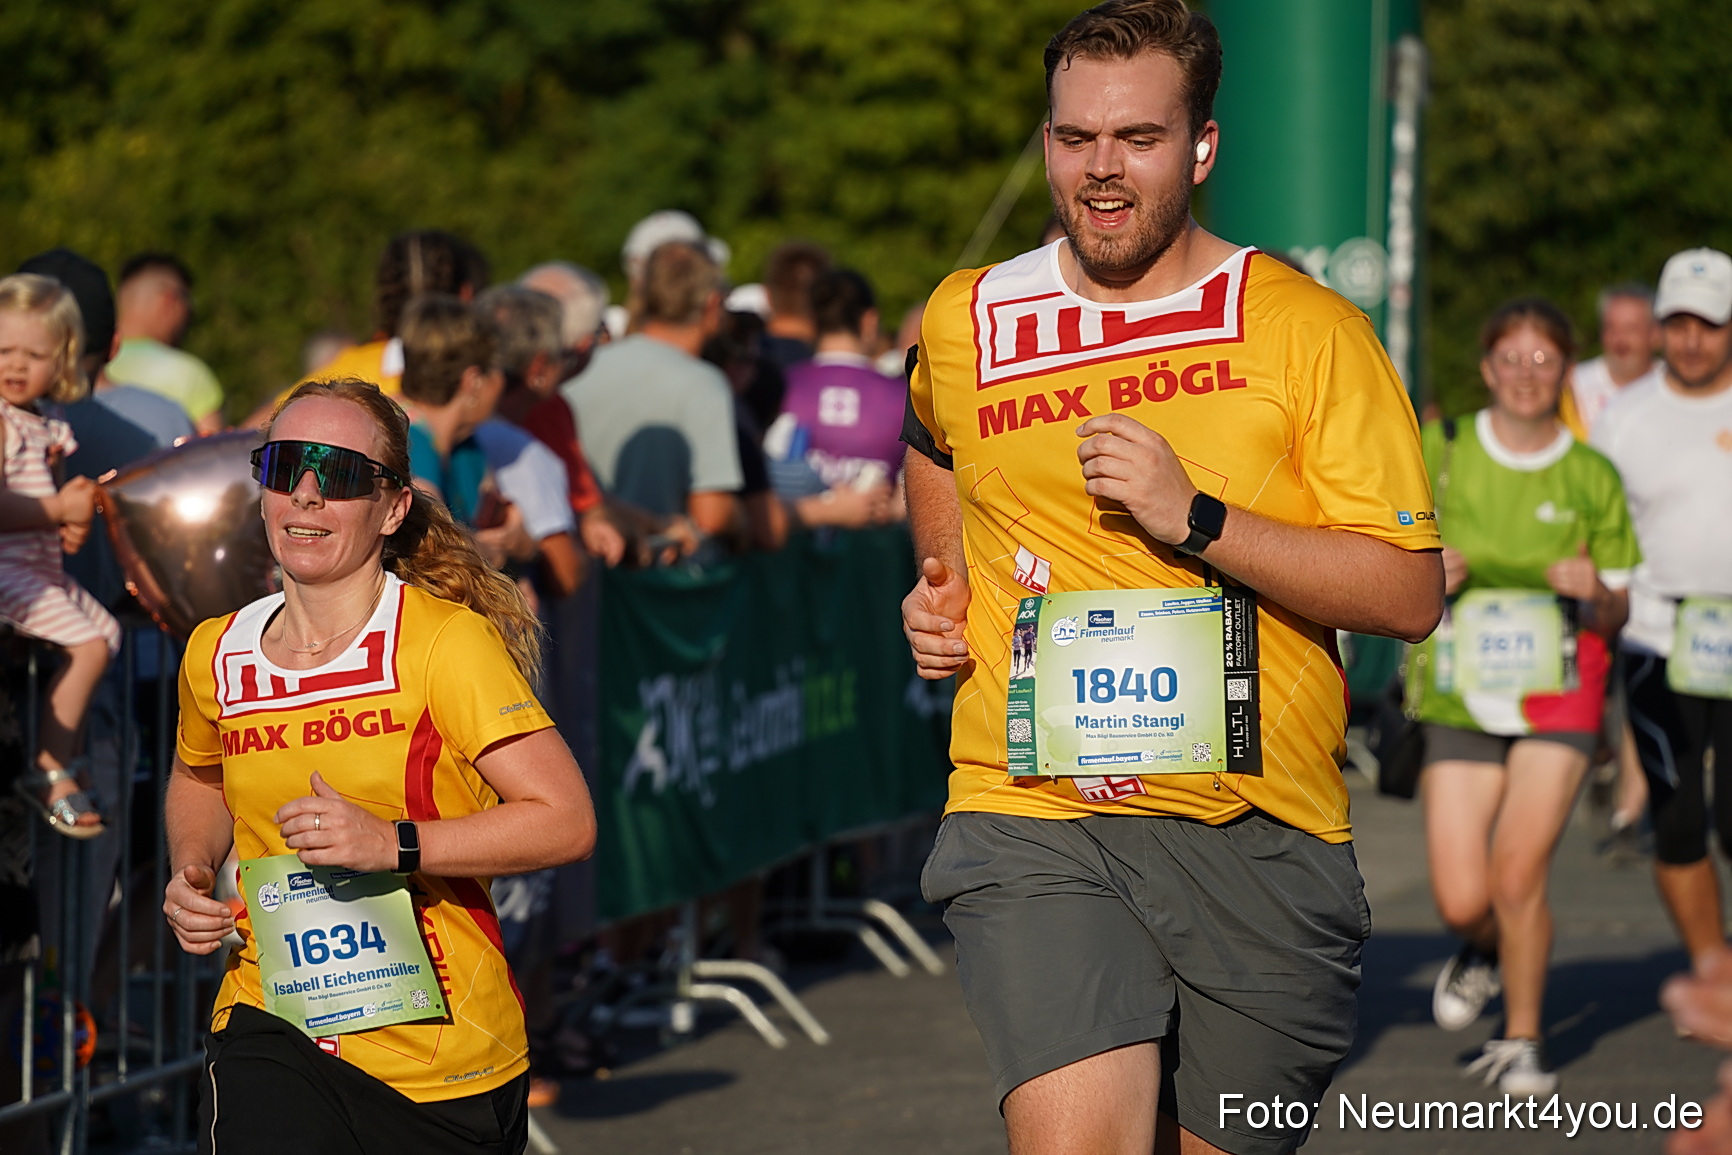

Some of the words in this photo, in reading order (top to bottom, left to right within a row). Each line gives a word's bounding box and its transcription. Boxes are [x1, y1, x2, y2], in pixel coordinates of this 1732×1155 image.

[977, 384, 1092, 440] MAX
[1108, 359, 1247, 411] BÖGL
[1018, 610, 1036, 619] AOK
[1224, 598, 1233, 641] RABATT
[1234, 598, 1242, 630] OUTLET
[1080, 625, 1135, 638] Firmenlauf
[1101, 635, 1134, 643] neumarkt
[1225, 643, 1233, 651] %
[1226, 652, 1234, 667] 20
[1072, 667, 1177, 703] 1840
[1075, 714, 1127, 729] Martin
[1132, 713, 1184, 731] Stangl
[222, 723, 289, 758] MAX
[302, 707, 406, 747] BÖGL
[1232, 705, 1244, 758] HILTL
[1081, 755, 1138, 764] firmenlauf.bayern
[283, 885, 334, 902] Firmenlauf
[284, 921, 387, 968] 1634
[273, 976, 320, 996] Isabell
[323, 962, 420, 989] Eichenmüller
[308, 1010, 361, 1027] firmenlauf.bayern
